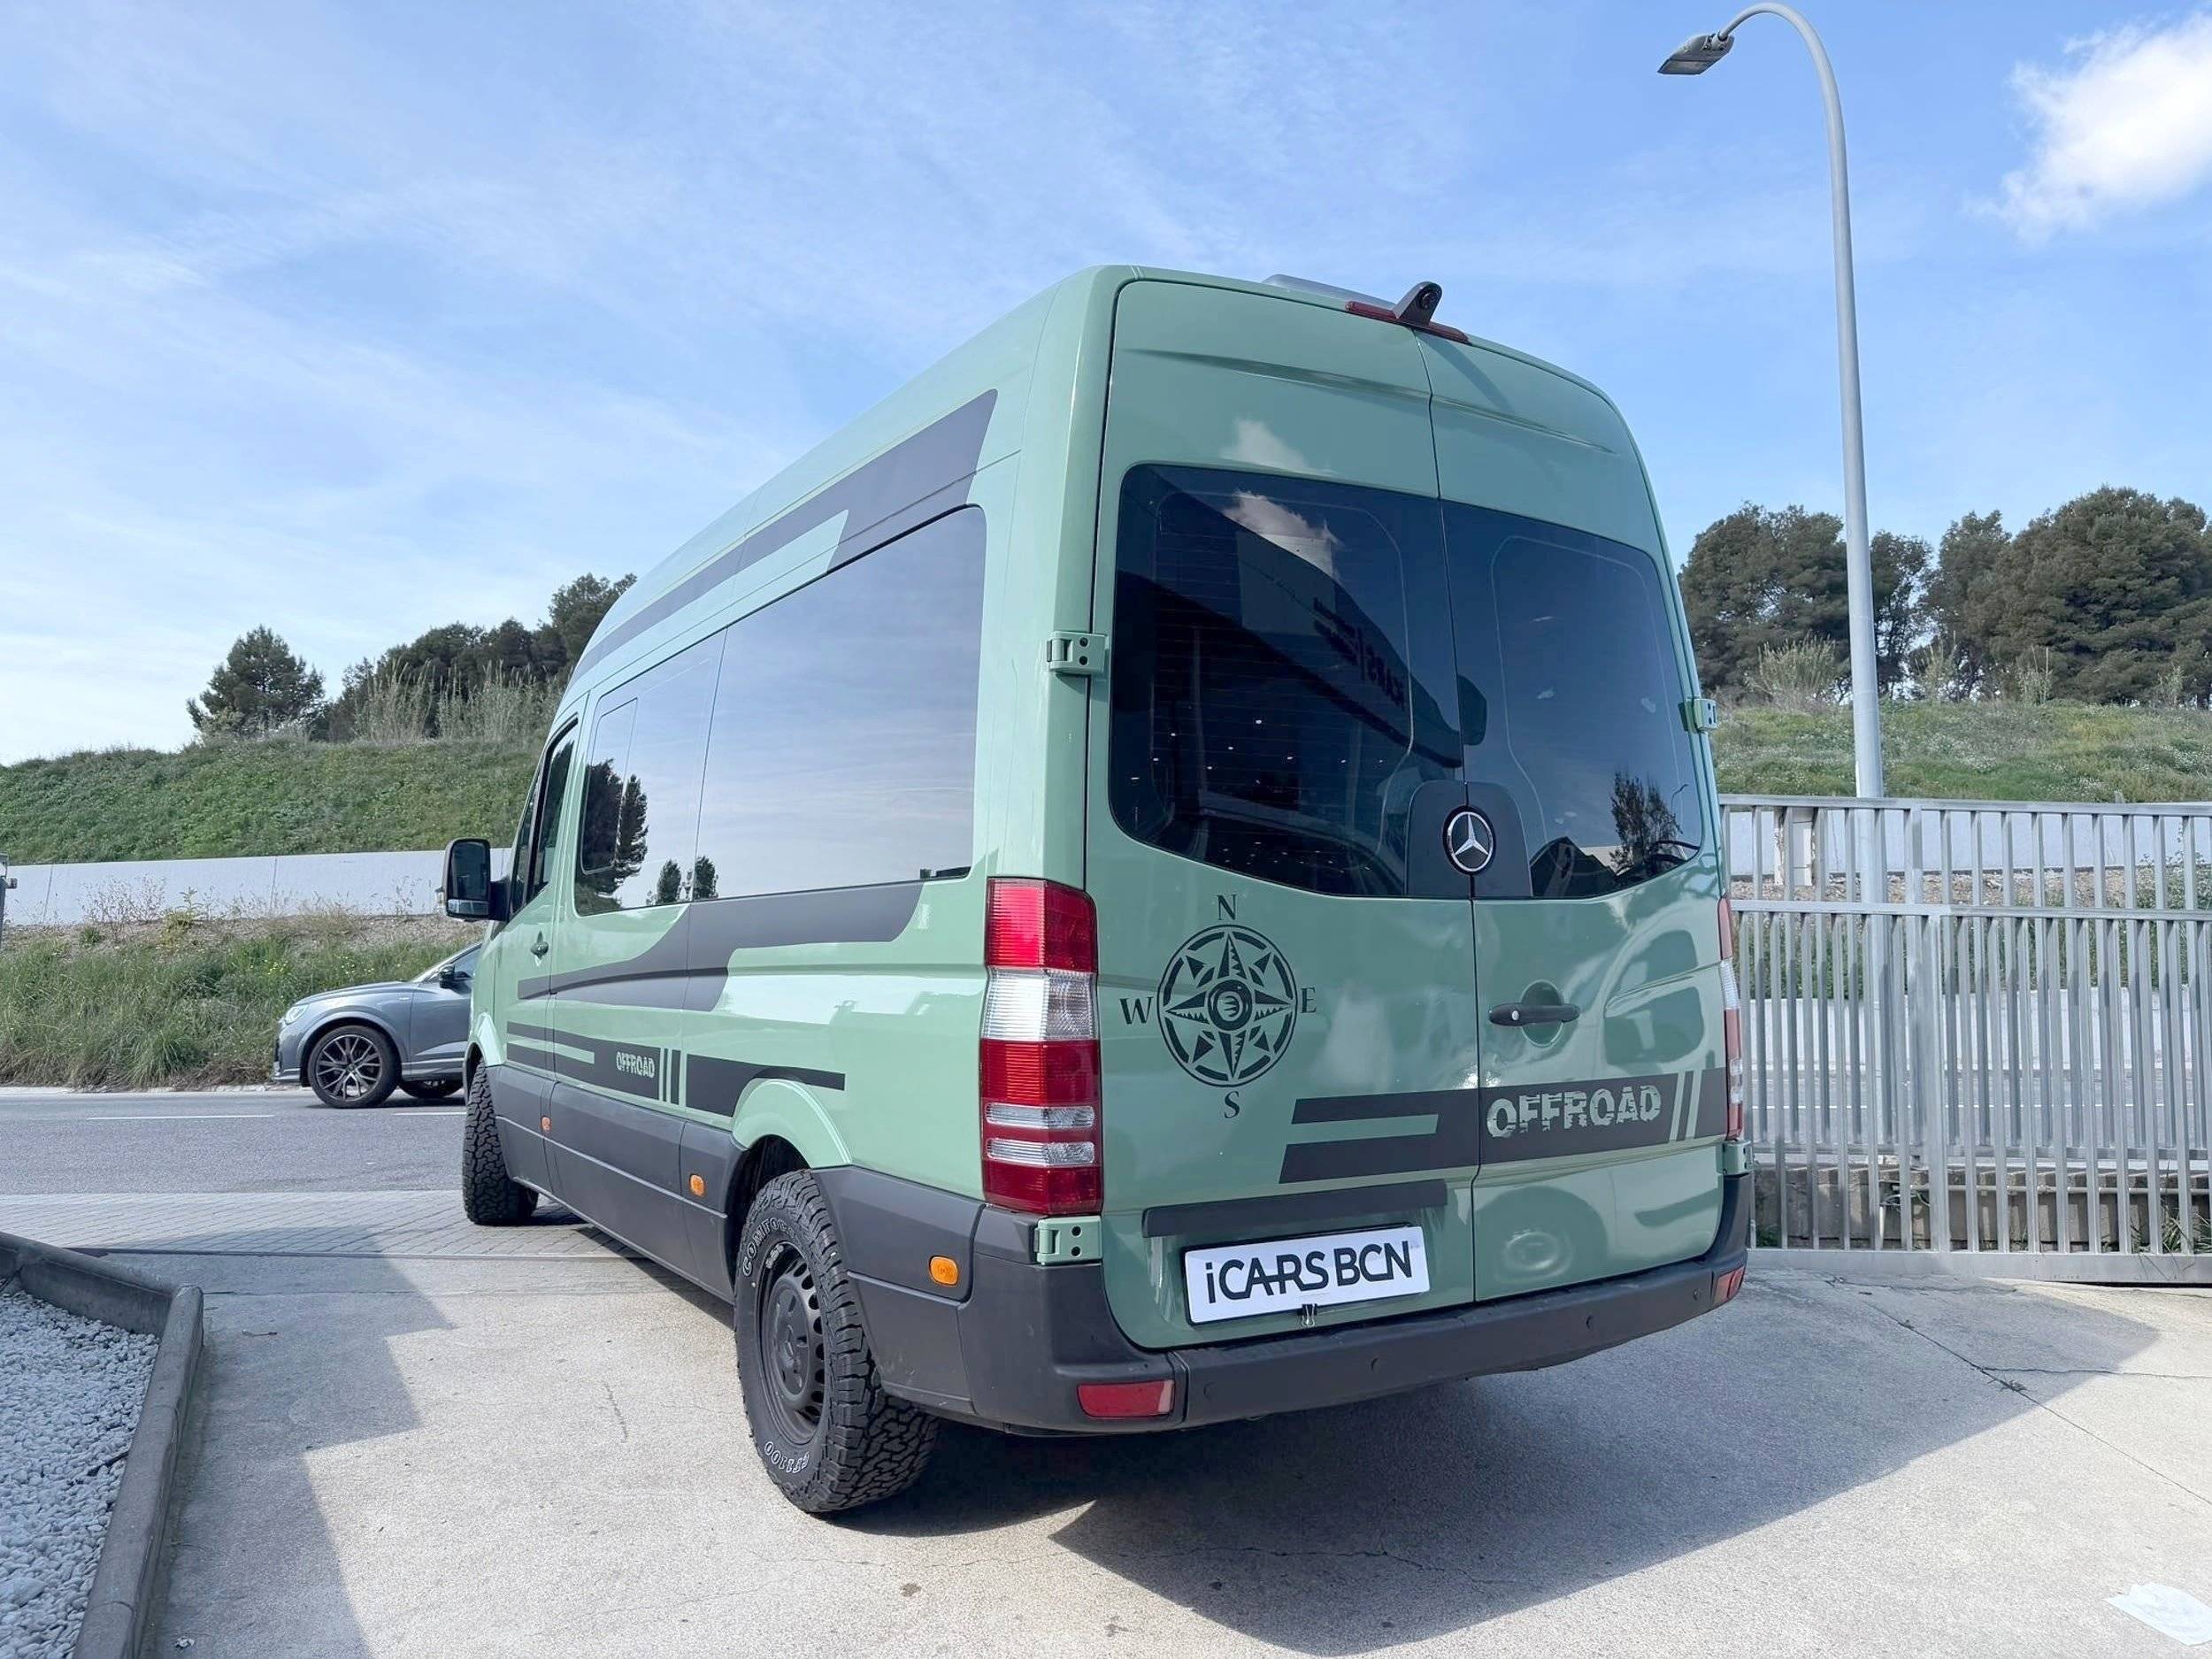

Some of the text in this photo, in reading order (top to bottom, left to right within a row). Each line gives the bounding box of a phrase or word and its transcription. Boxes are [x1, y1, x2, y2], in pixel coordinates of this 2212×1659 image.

[1217, 894, 1239, 921] N
[1119, 996, 1154, 1025] W
[1301, 987, 1317, 1014] E
[616, 1051, 655, 1079] OFFROAD
[1224, 1091, 1240, 1118] S
[1486, 1085, 1662, 1139] OFFROAD
[1333, 1240, 1412, 1286] BCN
